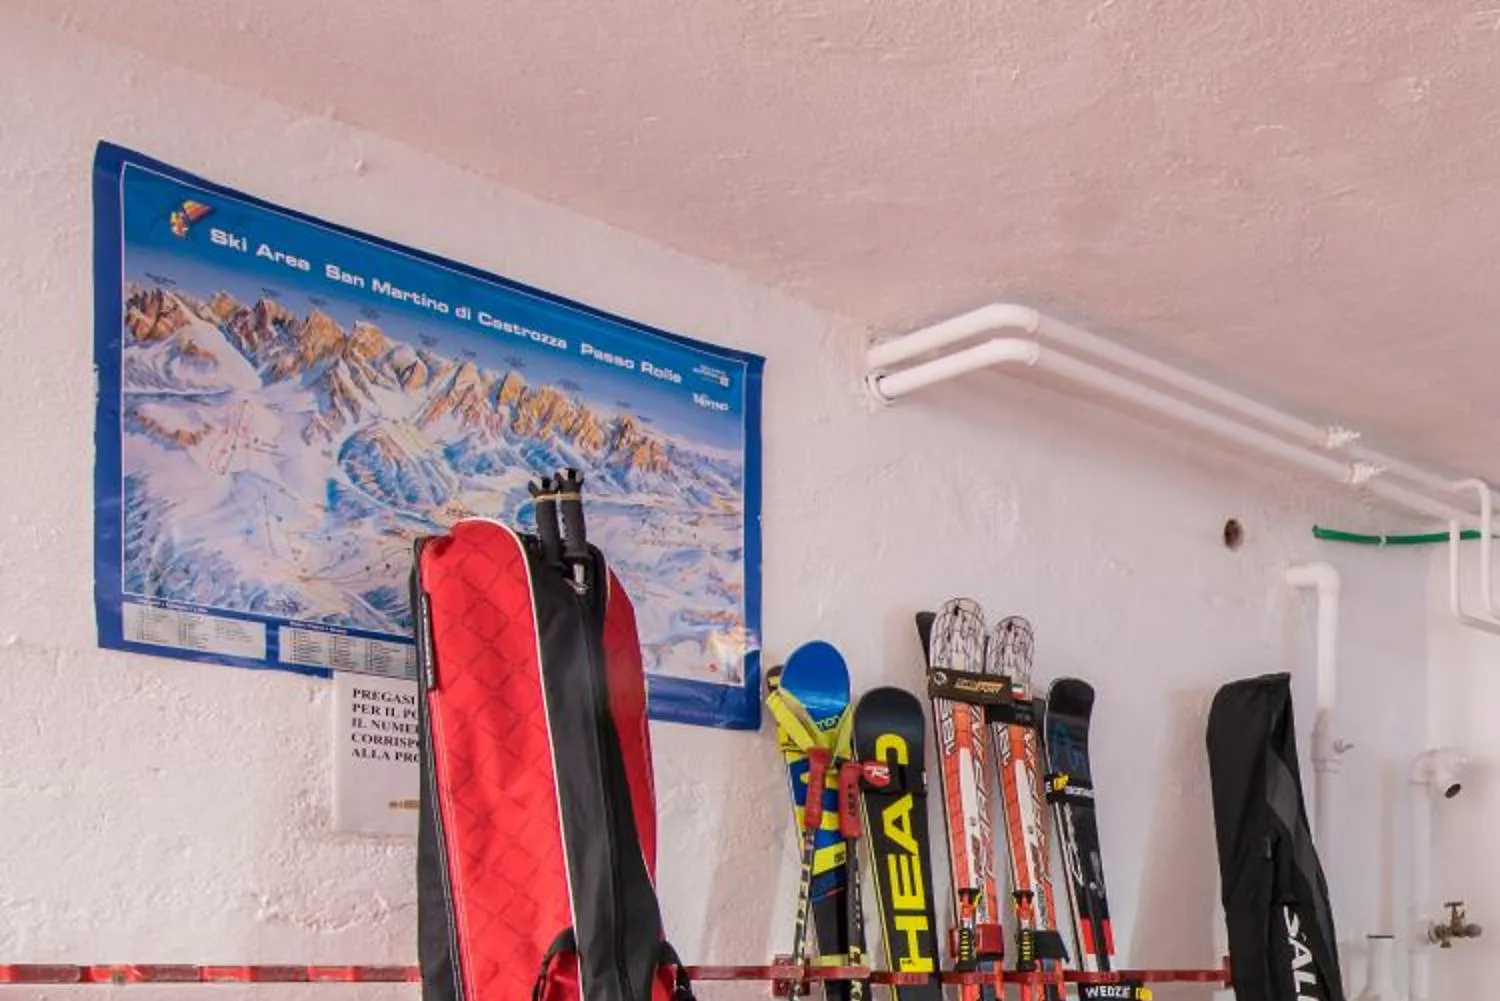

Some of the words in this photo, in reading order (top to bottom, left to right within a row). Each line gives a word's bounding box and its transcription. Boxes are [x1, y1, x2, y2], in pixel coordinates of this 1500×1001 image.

[209, 228, 247, 252] Ski
[256, 243, 311, 271] Area
[325, 264, 364, 288] San
[371, 278, 450, 313] Martino
[455, 306, 471, 320] di
[477, 311, 567, 350] Castrozza
[580, 342, 635, 370] Passo
[641, 361, 682, 384] Rolle
